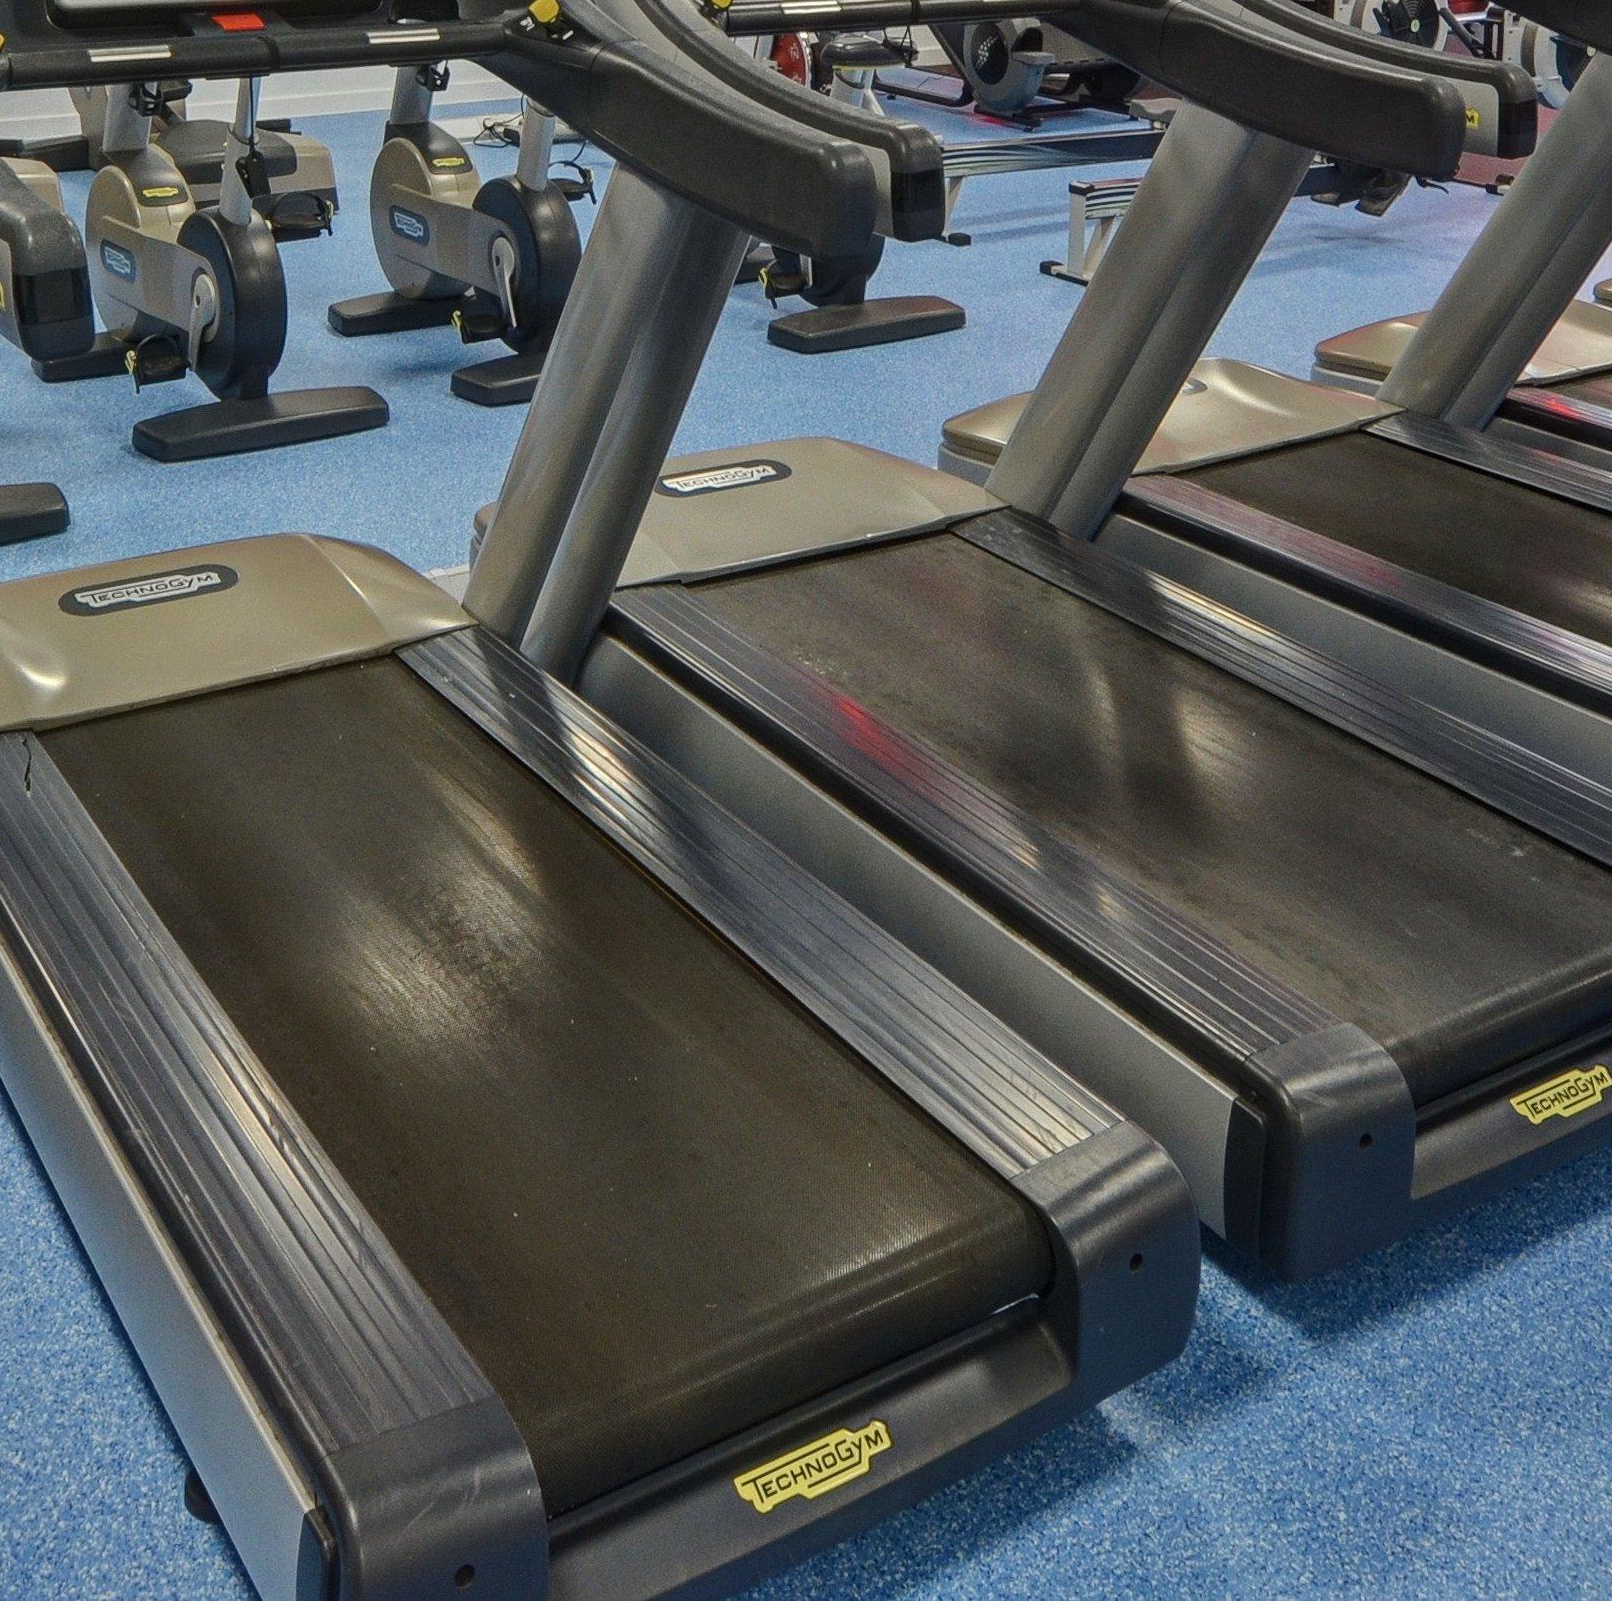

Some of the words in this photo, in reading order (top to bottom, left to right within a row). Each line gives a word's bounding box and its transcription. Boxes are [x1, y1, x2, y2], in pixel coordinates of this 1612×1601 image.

[666, 467, 772, 489] TECHNOGYM
[82, 573, 214, 604] TECHNOGYM
[1515, 1071, 1609, 1119] TECHNOGYM
[741, 1429, 884, 1504] TECHNOGYM
